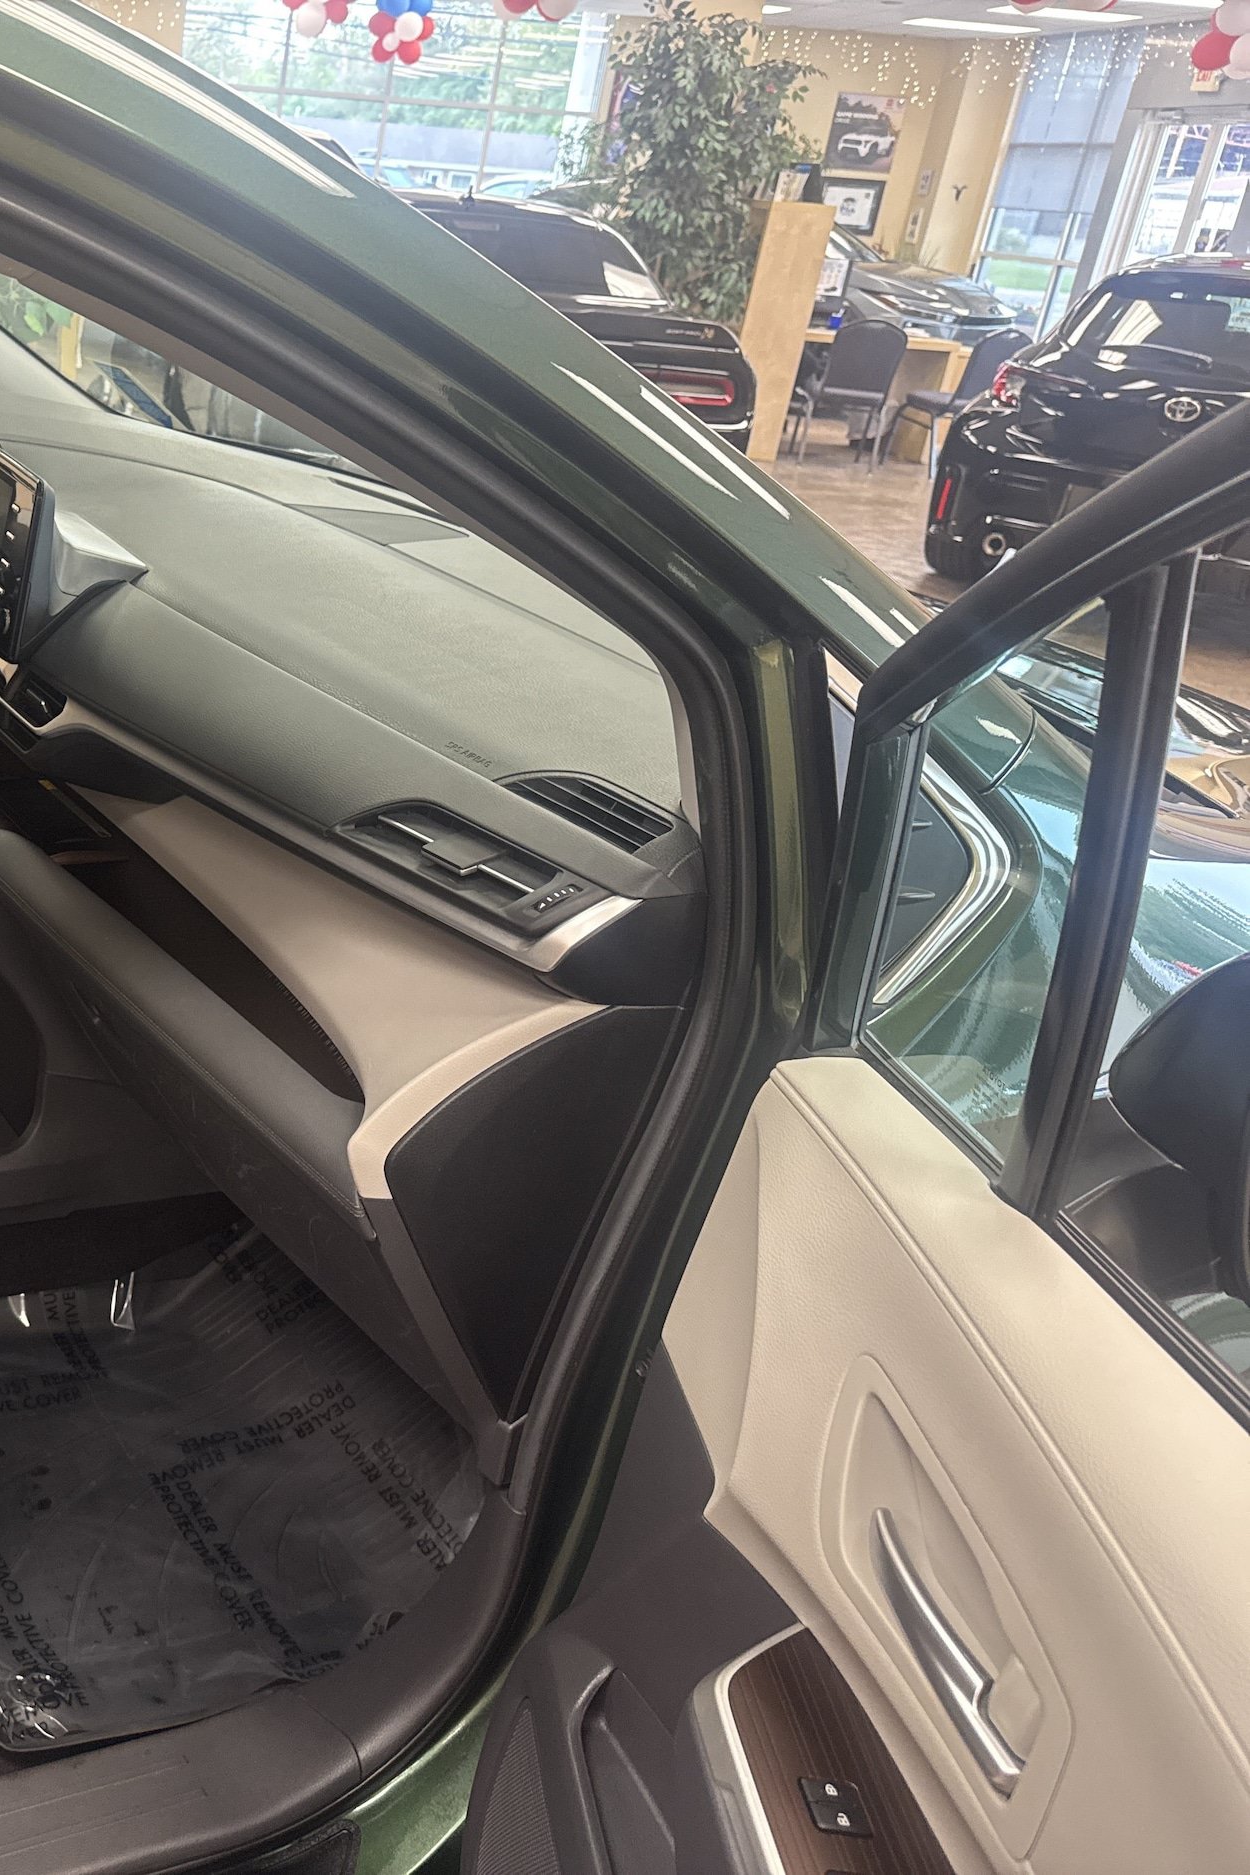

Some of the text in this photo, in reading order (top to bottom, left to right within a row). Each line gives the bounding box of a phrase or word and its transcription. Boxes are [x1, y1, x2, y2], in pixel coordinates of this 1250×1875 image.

[21, 1385, 83, 1410] COVER
[176, 1379, 345, 1455] PROTECTIVE COVER
[147, 1394, 357, 1486] DEALER MUST REMOVE
[329, 1421, 383, 1484] REMOVE
[371, 1437, 415, 1489] COVER
[377, 1485, 419, 1530] MUST
[157, 1484, 255, 1631] PROTECTIVE COVER
[175, 1480, 219, 1535] DEALER
[248, 1586, 302, 1662] REMOVE
